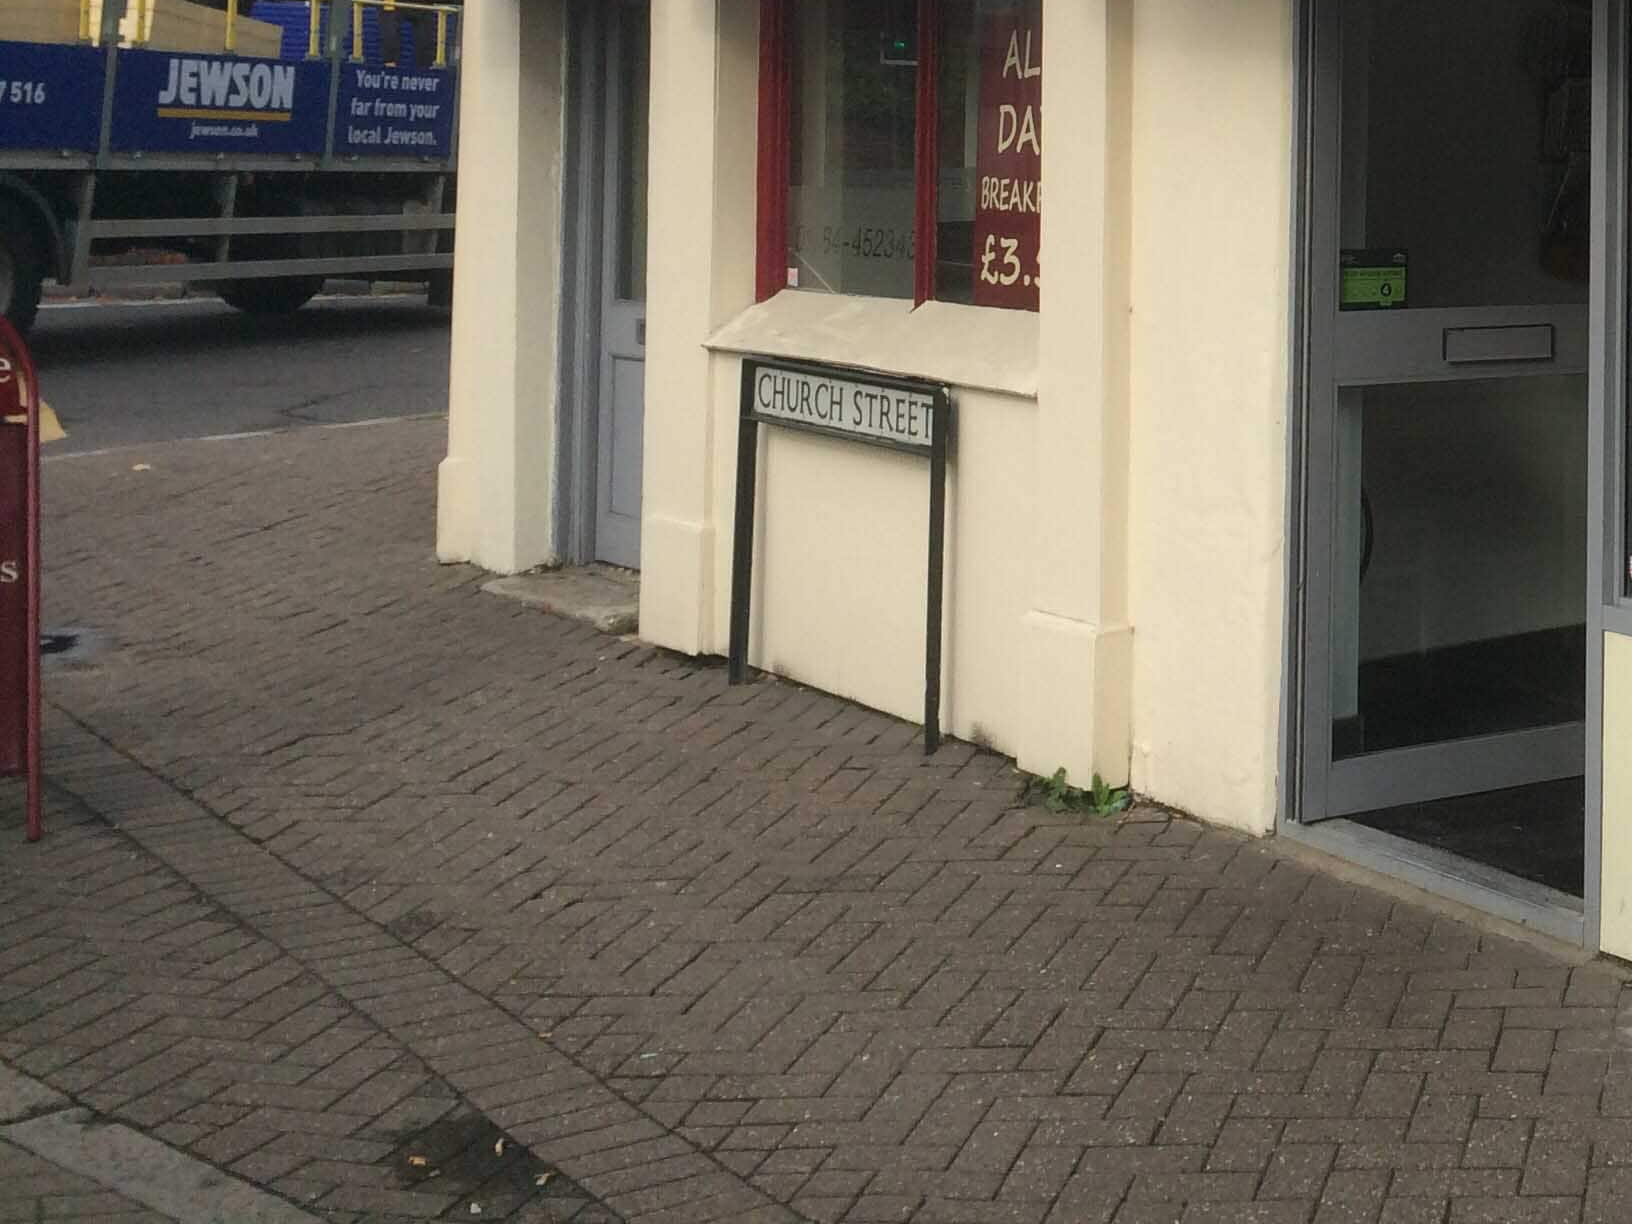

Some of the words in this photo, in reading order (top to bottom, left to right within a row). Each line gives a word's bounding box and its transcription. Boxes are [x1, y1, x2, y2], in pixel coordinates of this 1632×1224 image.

[158, 59, 294, 109] JEWSON
[356, 69, 399, 89] You're
[401, 76, 440, 91] never
[10, 81, 46, 104] 516
[351, 97, 372, 116] far
[374, 98, 407, 117] from
[409, 103, 440, 121] your
[348, 125, 381, 144] local
[384, 126, 437, 145] Jewson.
[998, 104, 1041, 156] DA
[758, 372, 844, 423] CHURCH
[852, 390, 934, 439] STREET
